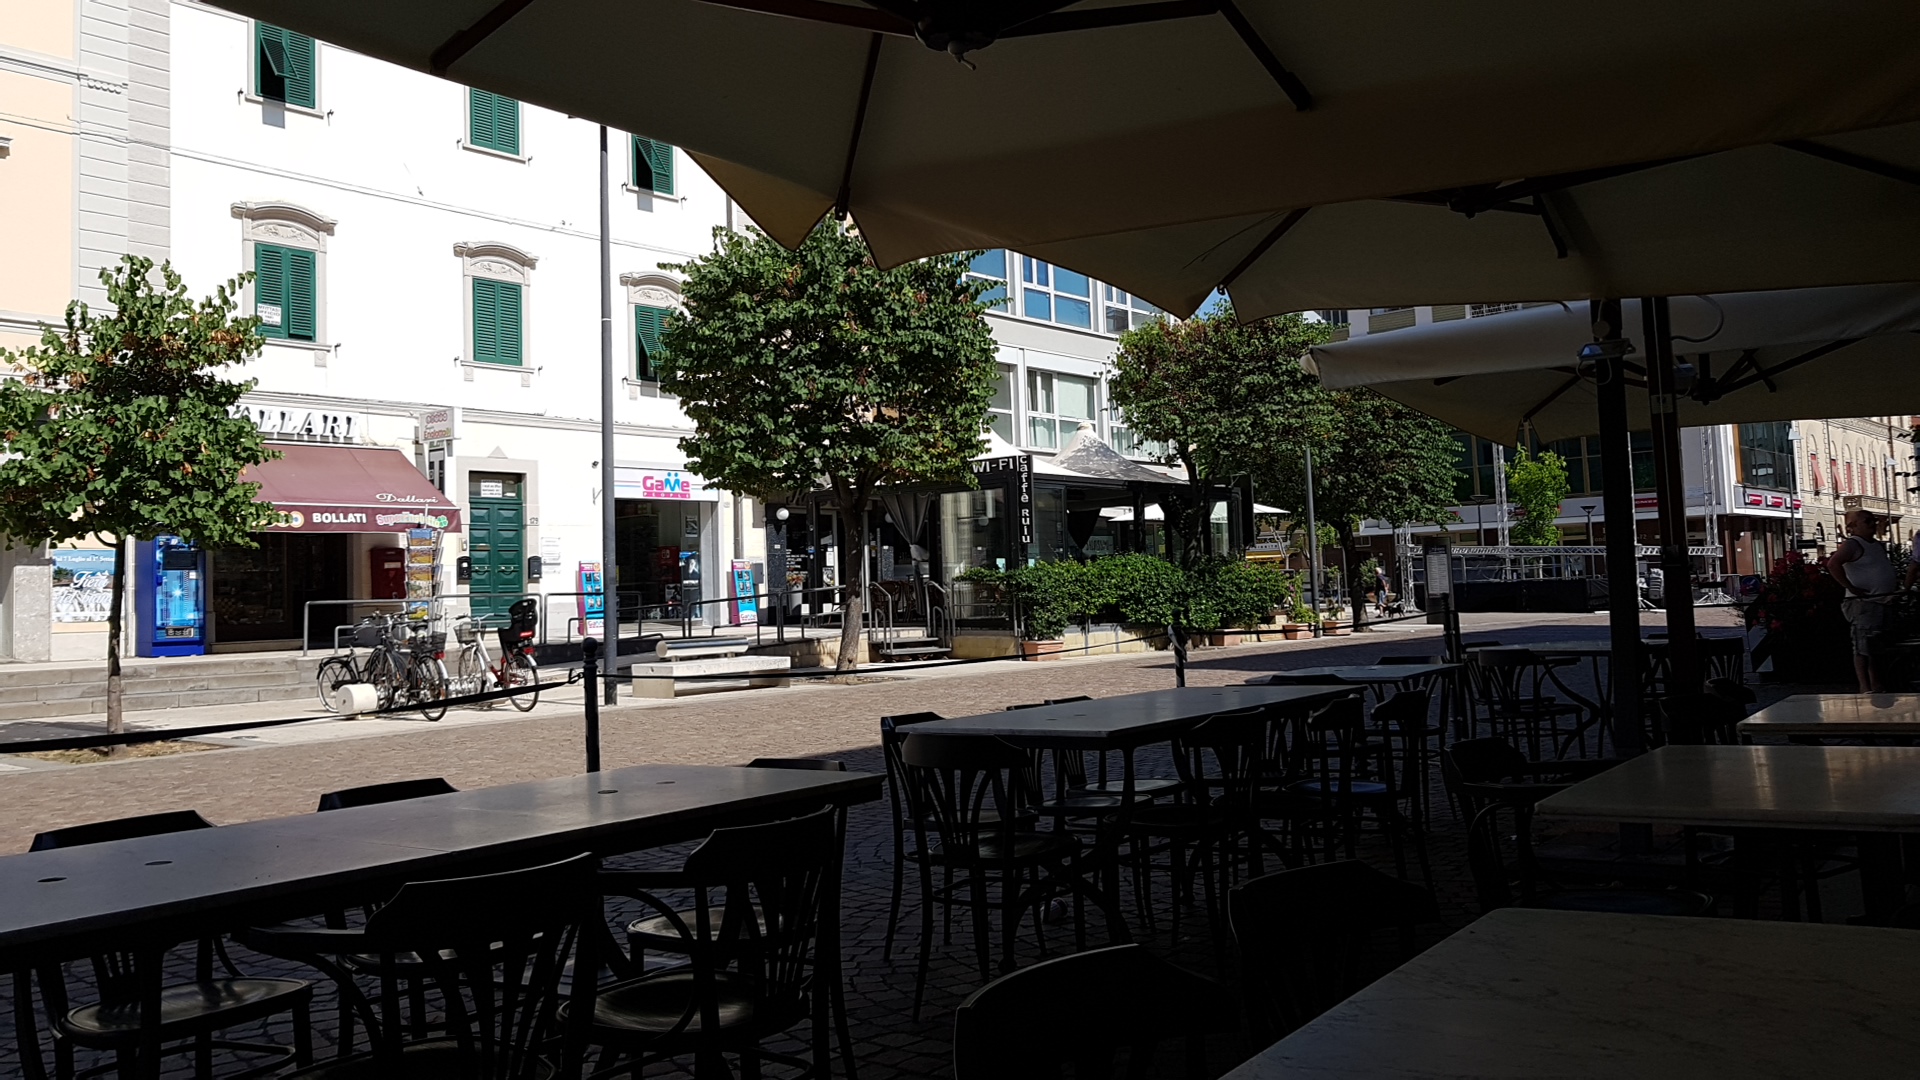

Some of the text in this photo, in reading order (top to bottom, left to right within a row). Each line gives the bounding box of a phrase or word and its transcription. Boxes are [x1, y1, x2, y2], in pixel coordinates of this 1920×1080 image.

[972, 458, 1014, 473] WI-FI
[376, 493, 438, 503] Dallari
[312, 512, 366, 523] BOLLATI
[70, 571, 109, 589] Fiera
